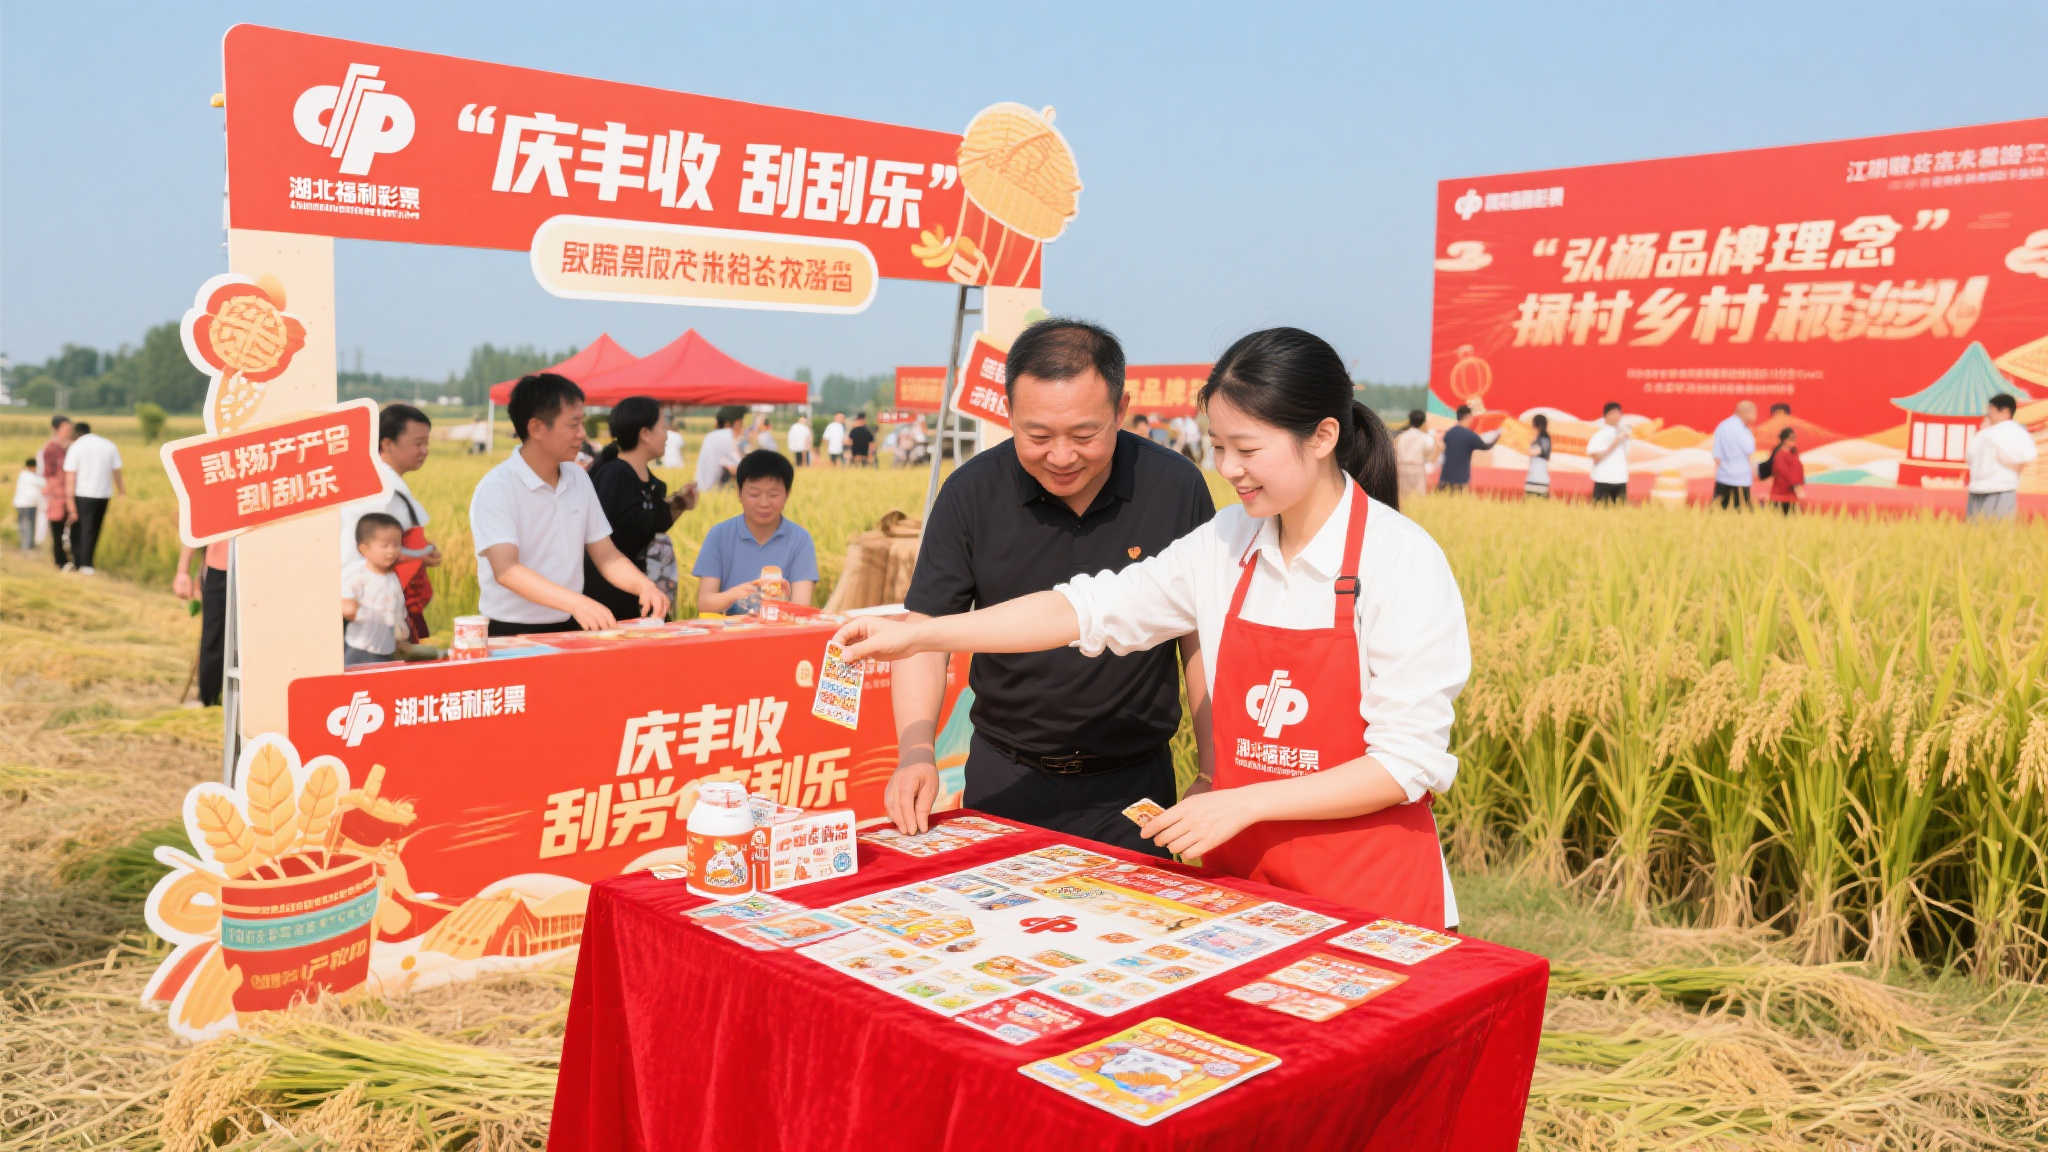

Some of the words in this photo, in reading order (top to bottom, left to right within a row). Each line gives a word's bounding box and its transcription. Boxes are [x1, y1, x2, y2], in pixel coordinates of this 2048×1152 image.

[289, 176, 420, 209] 湖北福利彩票
[394, 685, 526, 727] 湖北福利彩票
[616, 696, 788, 776] 庆丰收
